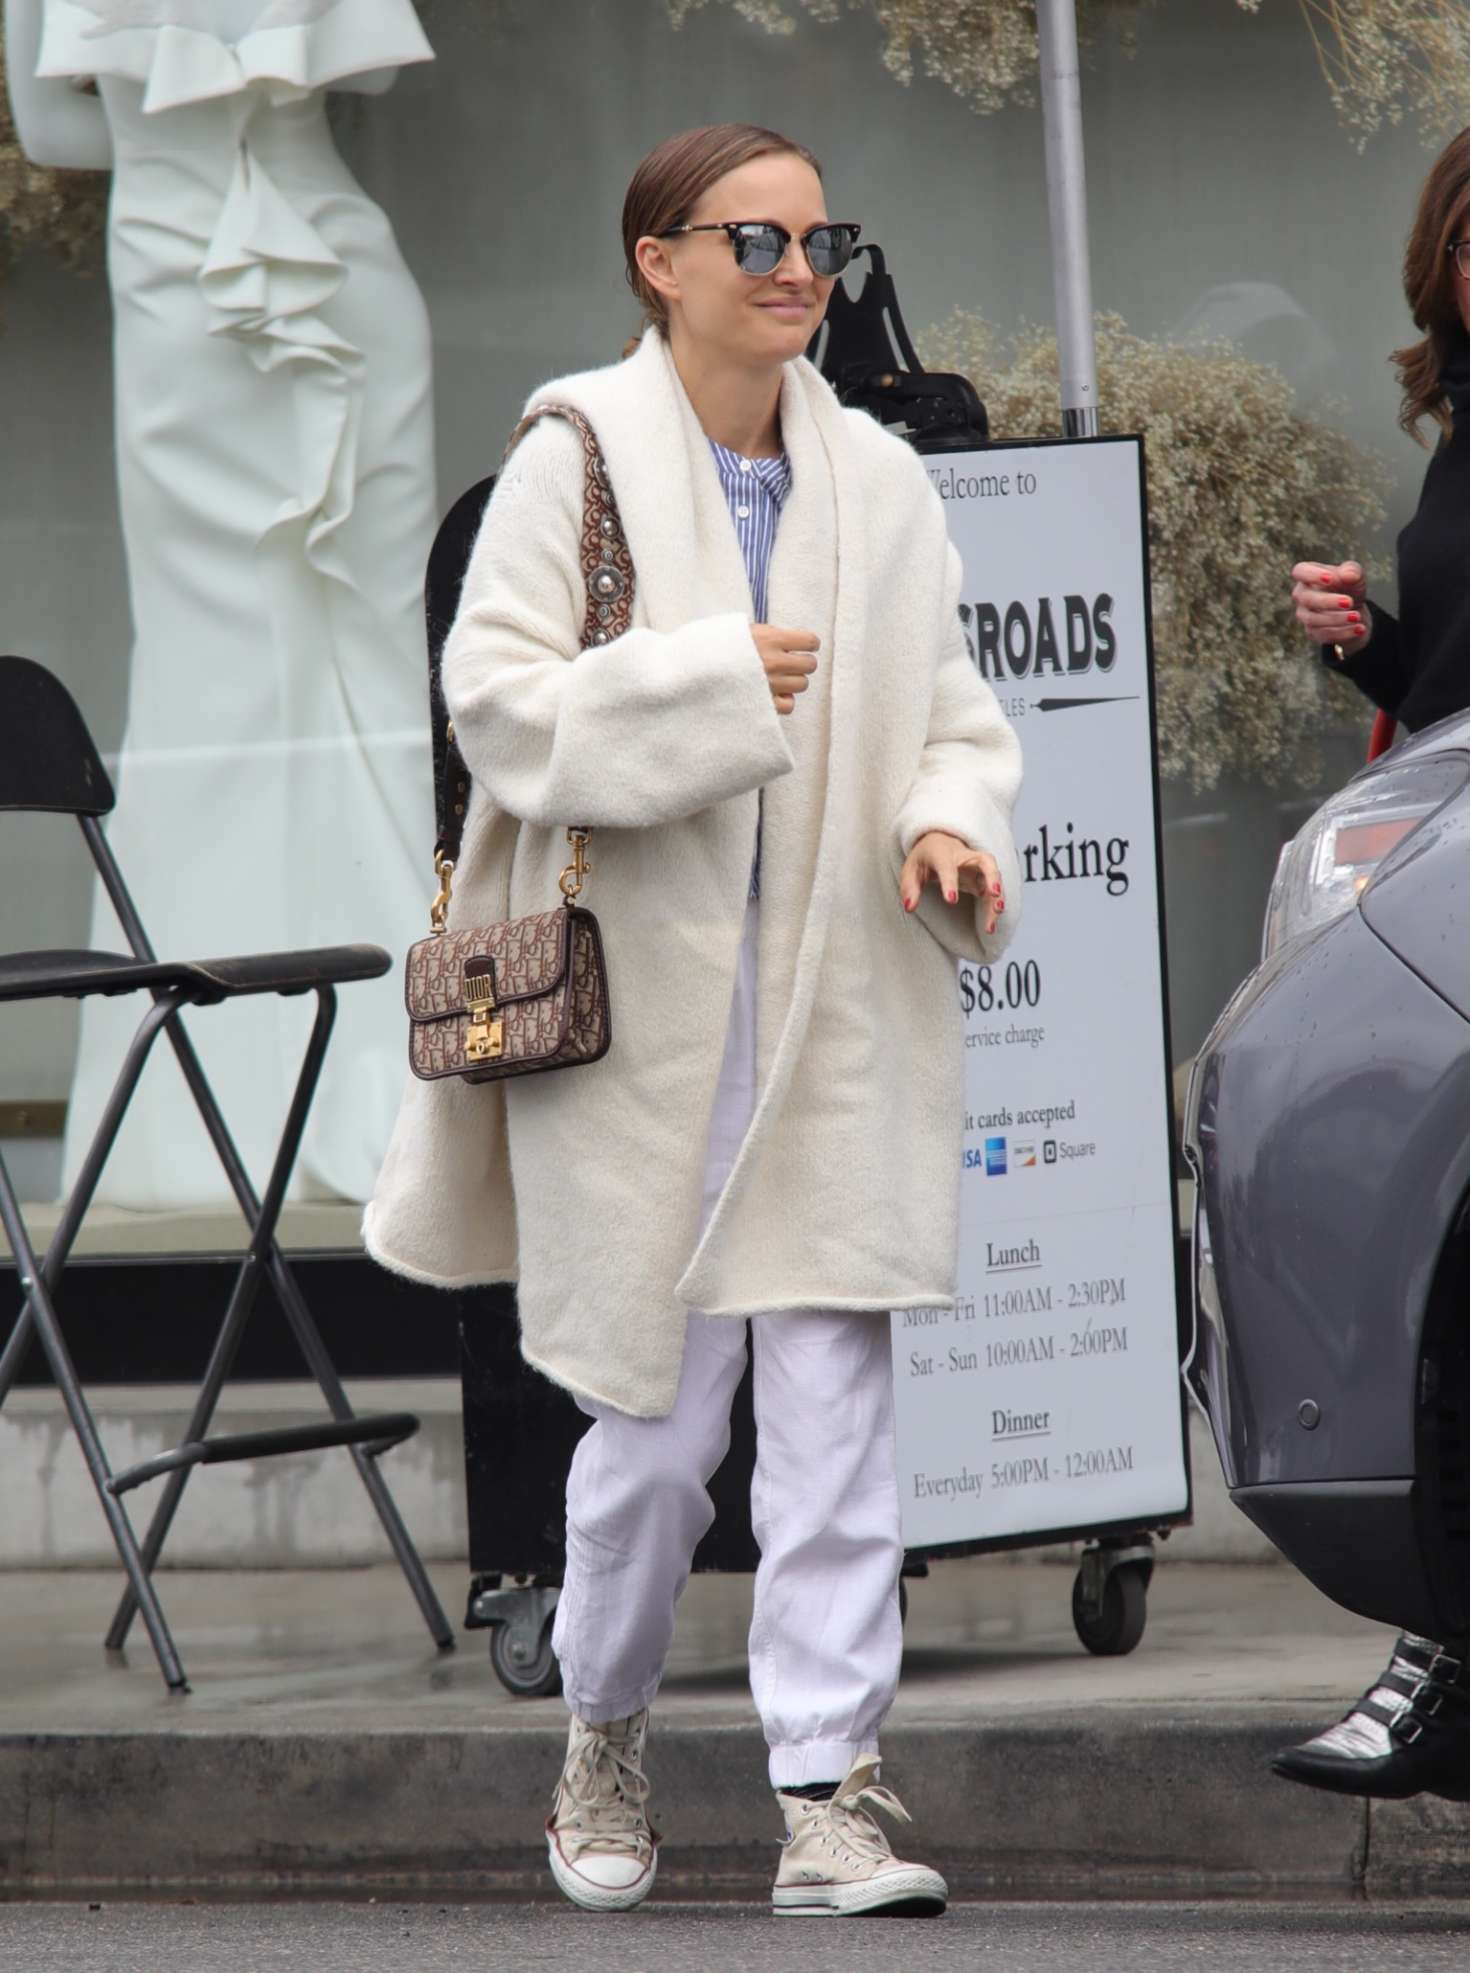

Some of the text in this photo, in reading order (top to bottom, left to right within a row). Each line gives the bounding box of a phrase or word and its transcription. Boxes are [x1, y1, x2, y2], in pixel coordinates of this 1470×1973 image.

[1016, 471, 1037, 495] to
[1017, 822, 1130, 896] rking
[464, 974, 492, 1001] DIOR
[959, 959, 1041, 1020] $8.00
[965, 1024, 1046, 1049] ervice charge
[964, 1099, 1076, 1130] it cards accepted
[962, 1148, 982, 1169] ISA
[1059, 1141, 1096, 1160] Square
[986, 1238, 1041, 1267] Lunch
[902, 1309, 940, 1328] Mon
[953, 1295, 976, 1321] Fri
[984, 1286, 1053, 1318] 11:00AM
[1067, 1277, 1127, 1309] 2:30PM
[909, 1351, 934, 1377] Sat
[948, 1346, 978, 1373] Sun
[985, 1335, 1054, 1367] 10:00AM
[1070, 1326, 1128, 1357] 2:00PM
[991, 1409, 1050, 1435] Dinner
[913, 1466, 984, 1502] Everyday
[990, 1457, 1049, 1490] 5:00PM
[1064, 1446, 1134, 1479] 12:00AM
